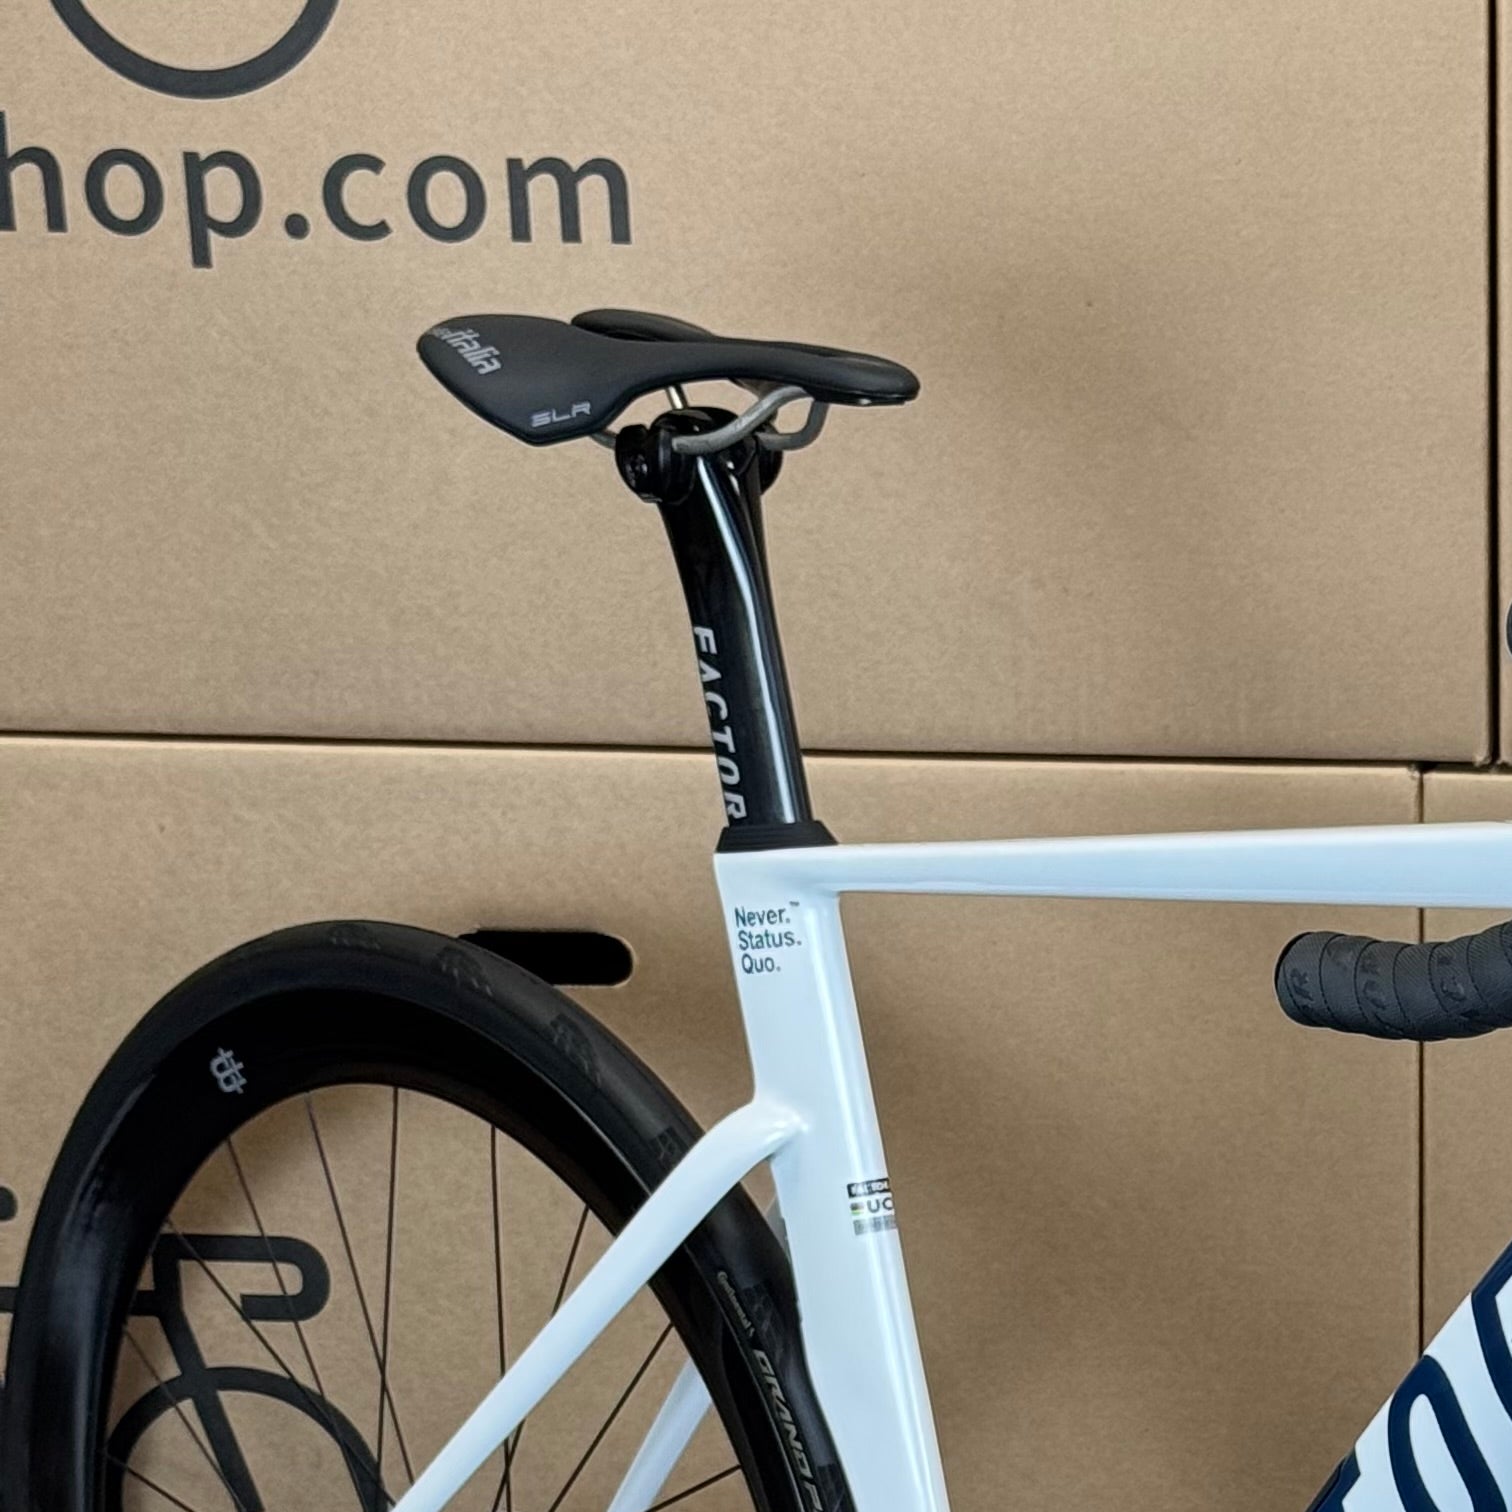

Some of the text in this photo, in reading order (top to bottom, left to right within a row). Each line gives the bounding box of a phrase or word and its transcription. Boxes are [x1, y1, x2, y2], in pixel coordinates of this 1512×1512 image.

[531, 402, 591, 428] SLR
[693, 625, 747, 821] FACTOR
[735, 906, 791, 928] Never.
[738, 929, 802, 951] Status.
[741, 953, 782, 975] Quo.
[752, 1349, 815, 1485] GRAND
